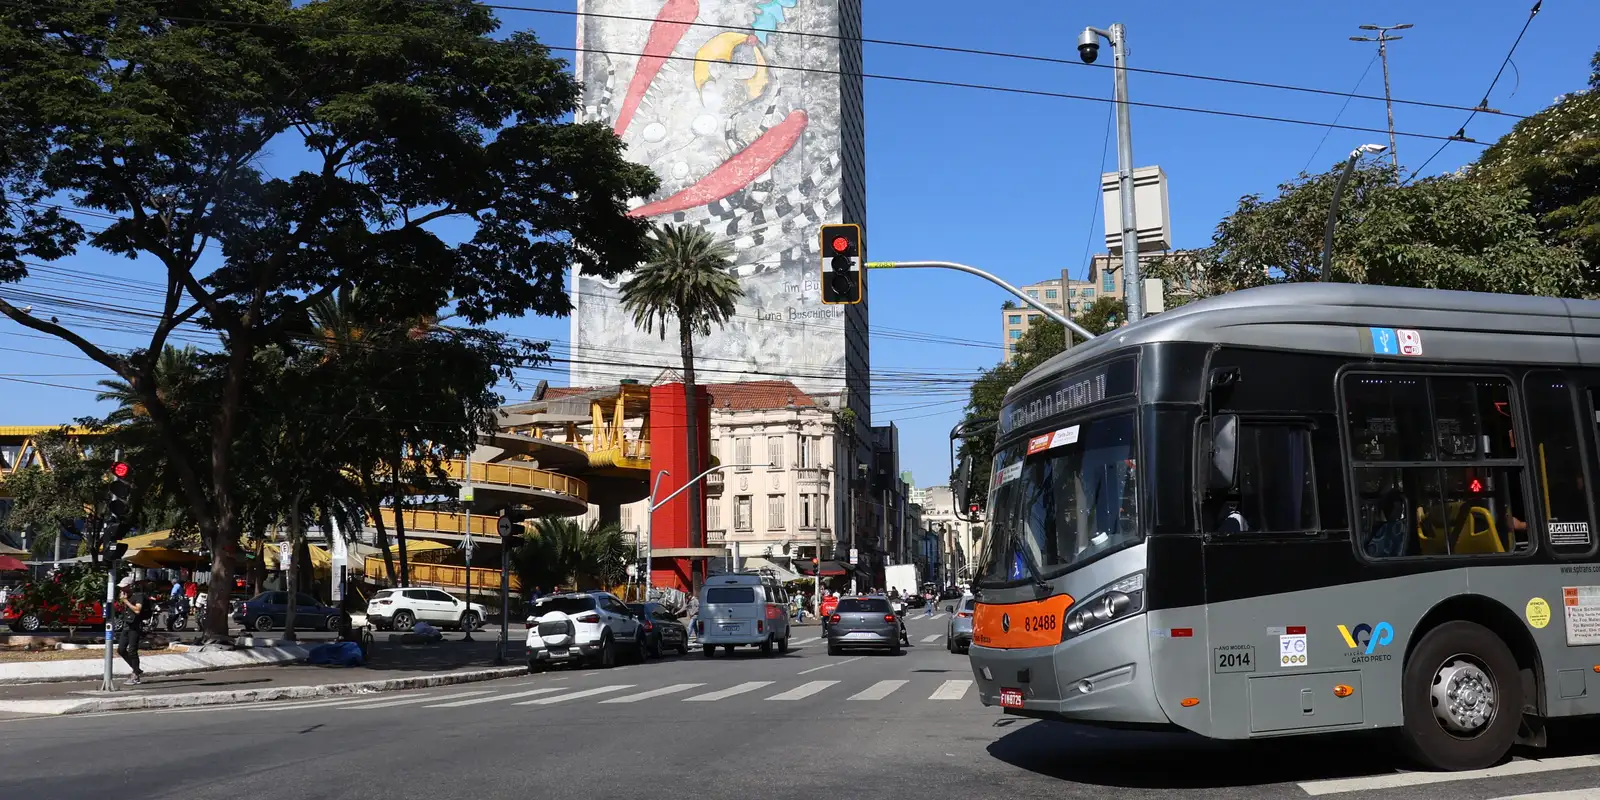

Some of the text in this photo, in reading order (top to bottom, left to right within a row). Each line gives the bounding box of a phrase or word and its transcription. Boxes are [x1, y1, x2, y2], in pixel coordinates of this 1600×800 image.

[782, 281, 800, 293] Tim
[1025, 614, 1056, 632] 8 2488
[1219, 652, 1251, 668] 2014
[1370, 654, 1392, 662] PRETO
